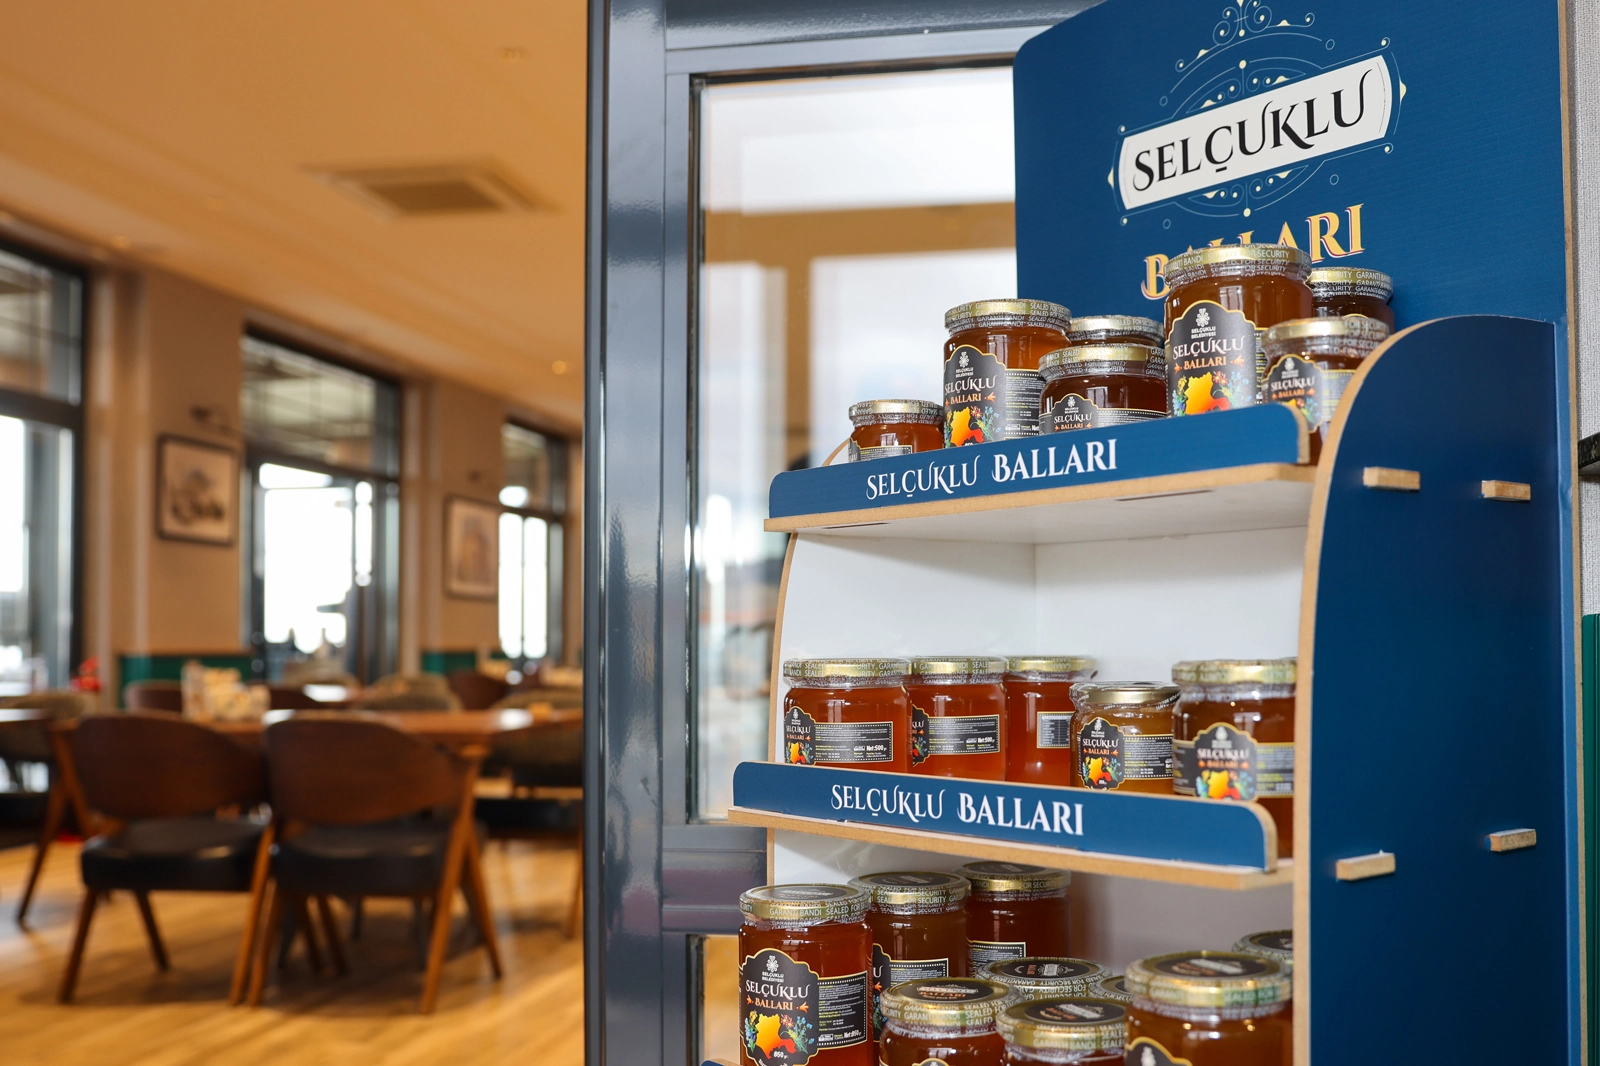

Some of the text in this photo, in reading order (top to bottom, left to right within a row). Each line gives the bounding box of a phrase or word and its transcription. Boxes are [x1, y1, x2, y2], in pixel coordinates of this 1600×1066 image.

[1132, 69, 1372, 191] SELÇUKLU
[1184, 254, 1203, 266] BANDI
[1257, 249, 1290, 259] SECURITY
[1356, 271, 1380, 280] GARANTI
[1030, 303, 1049, 311] SEALED
[1062, 350, 1080, 358] SEALED
[1172, 335, 1246, 360] SELÇUKLU
[1183, 356, 1227, 371] BALLARI
[945, 375, 997, 395] SELÇUKLU
[951, 393, 982, 404] BALLARI
[866, 439, 1118, 500] SELÇUKLU BALLARI
[831, 784, 1084, 836] SELÇUKLU BALLARI
[917, 896, 946, 904] SECURITY
[769, 908, 799, 917] GARANTI
[800, 908, 822, 917] BANDI
[826, 905, 848, 916] SEALED
[746, 979, 810, 1000] SELÇUKLU
[755, 997, 793, 1011] BALLARI
[965, 1009, 992, 1019] SEALED
[1069, 1040, 1096, 1049] BANDI
